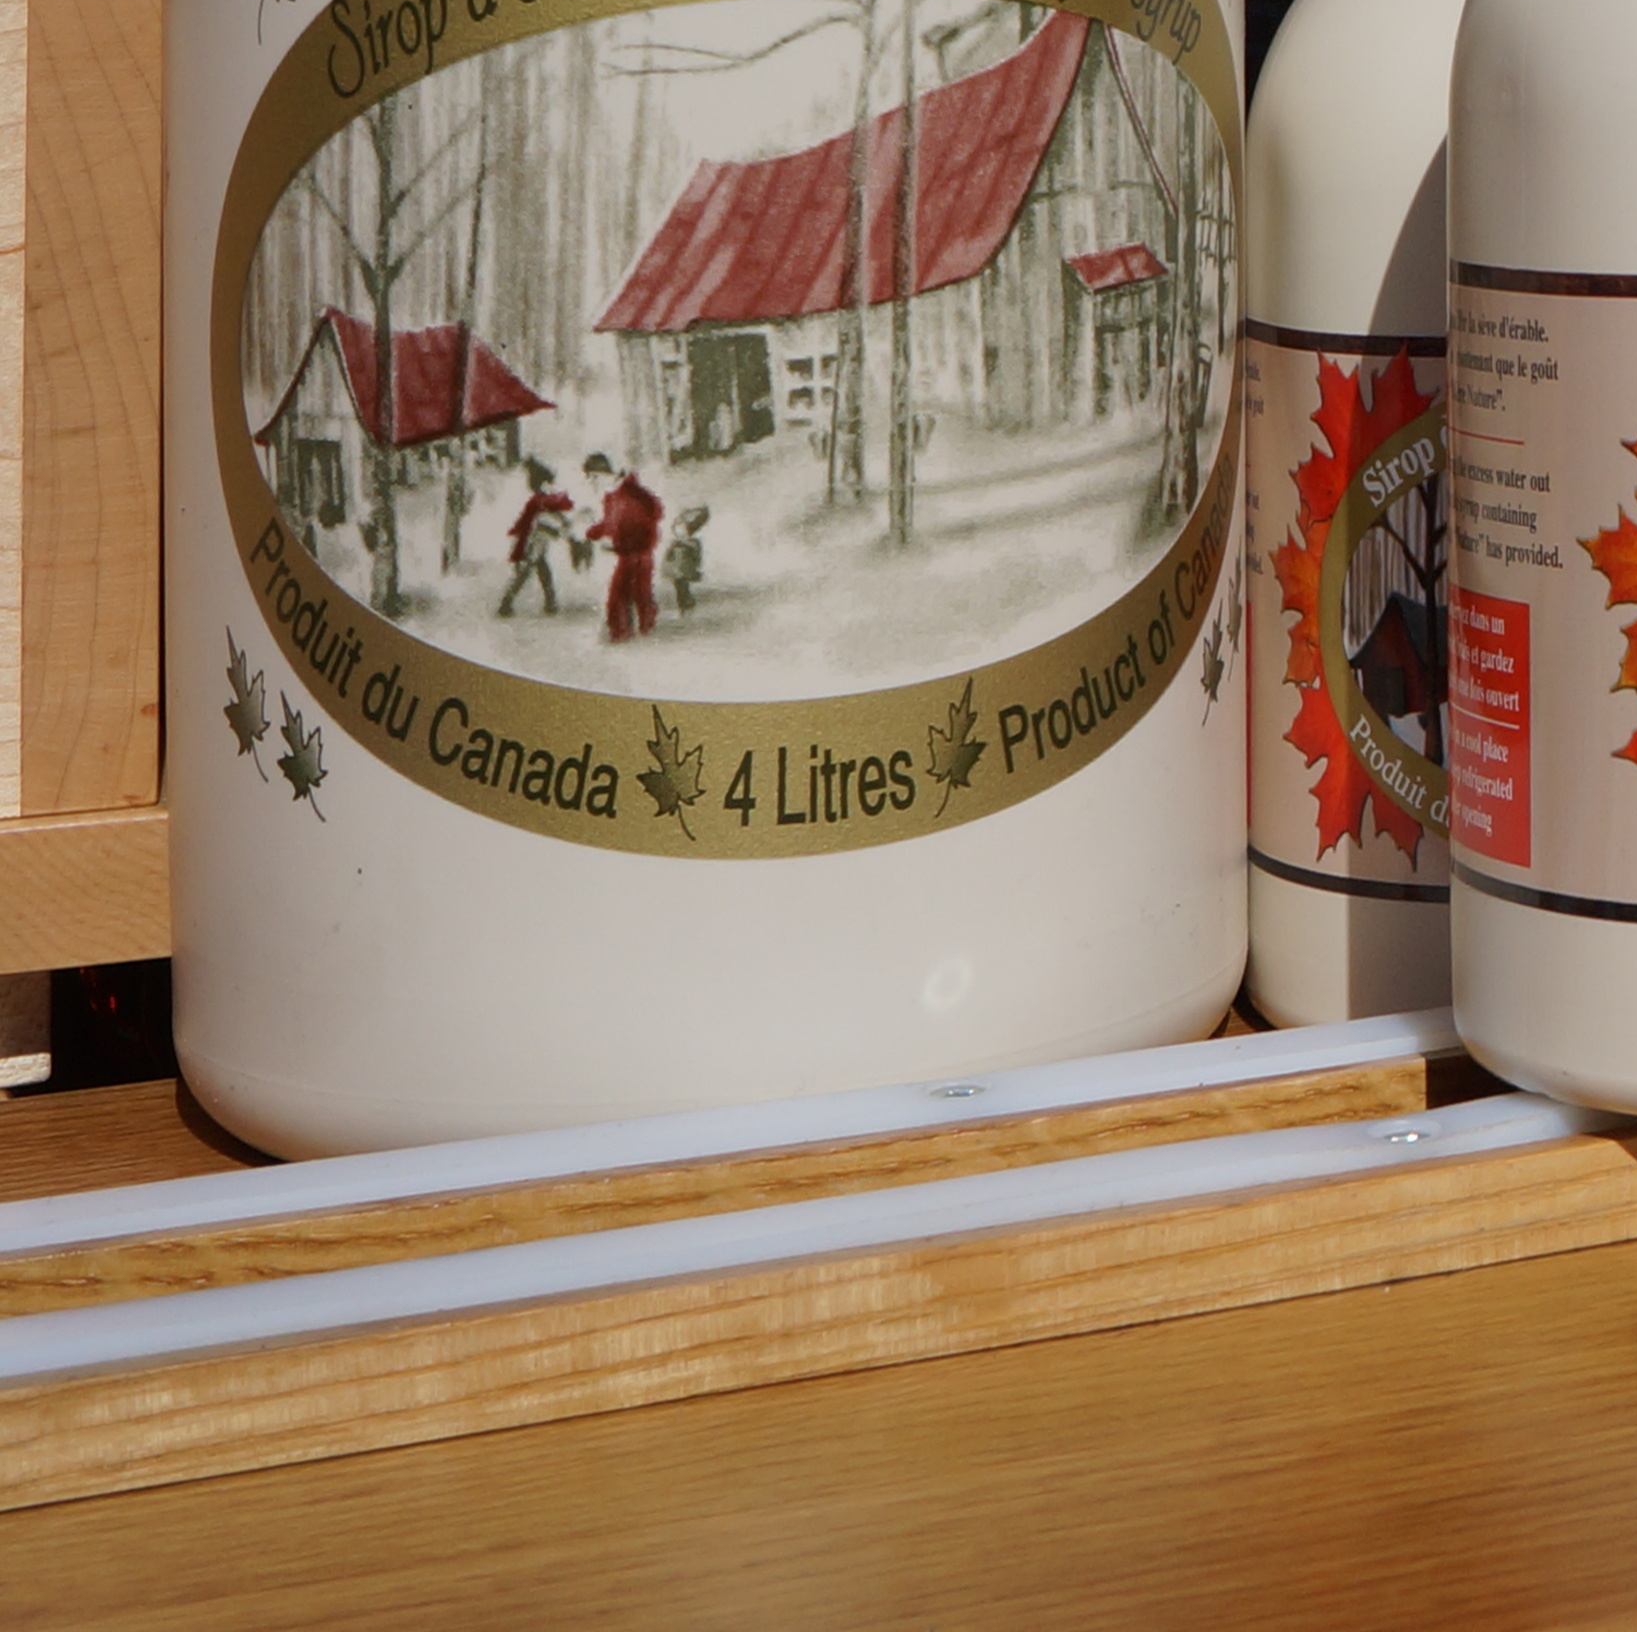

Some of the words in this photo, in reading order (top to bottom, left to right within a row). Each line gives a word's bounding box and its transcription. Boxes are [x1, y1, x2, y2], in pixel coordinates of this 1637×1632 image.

[1499, 314, 1549, 343] d'érable.
[1531, 357, 1559, 384] goût
[1363, 434, 1435, 508] Sirop
[1496, 467, 1526, 491] water
[1531, 472, 1551, 493] out
[1505, 541, 1563, 569] provided.
[249, 516, 365, 701] Produit
[359, 677, 419, 744] du
[427, 697, 619, 819] Canada
[722, 750, 755, 828] 4
[774, 746, 917, 828] Litres
[999, 656, 1143, 772] Product
[1148, 588, 1175, 665] of
[1175, 451, 1234, 620] Canada
[1349, 715, 1427, 814] Produit
